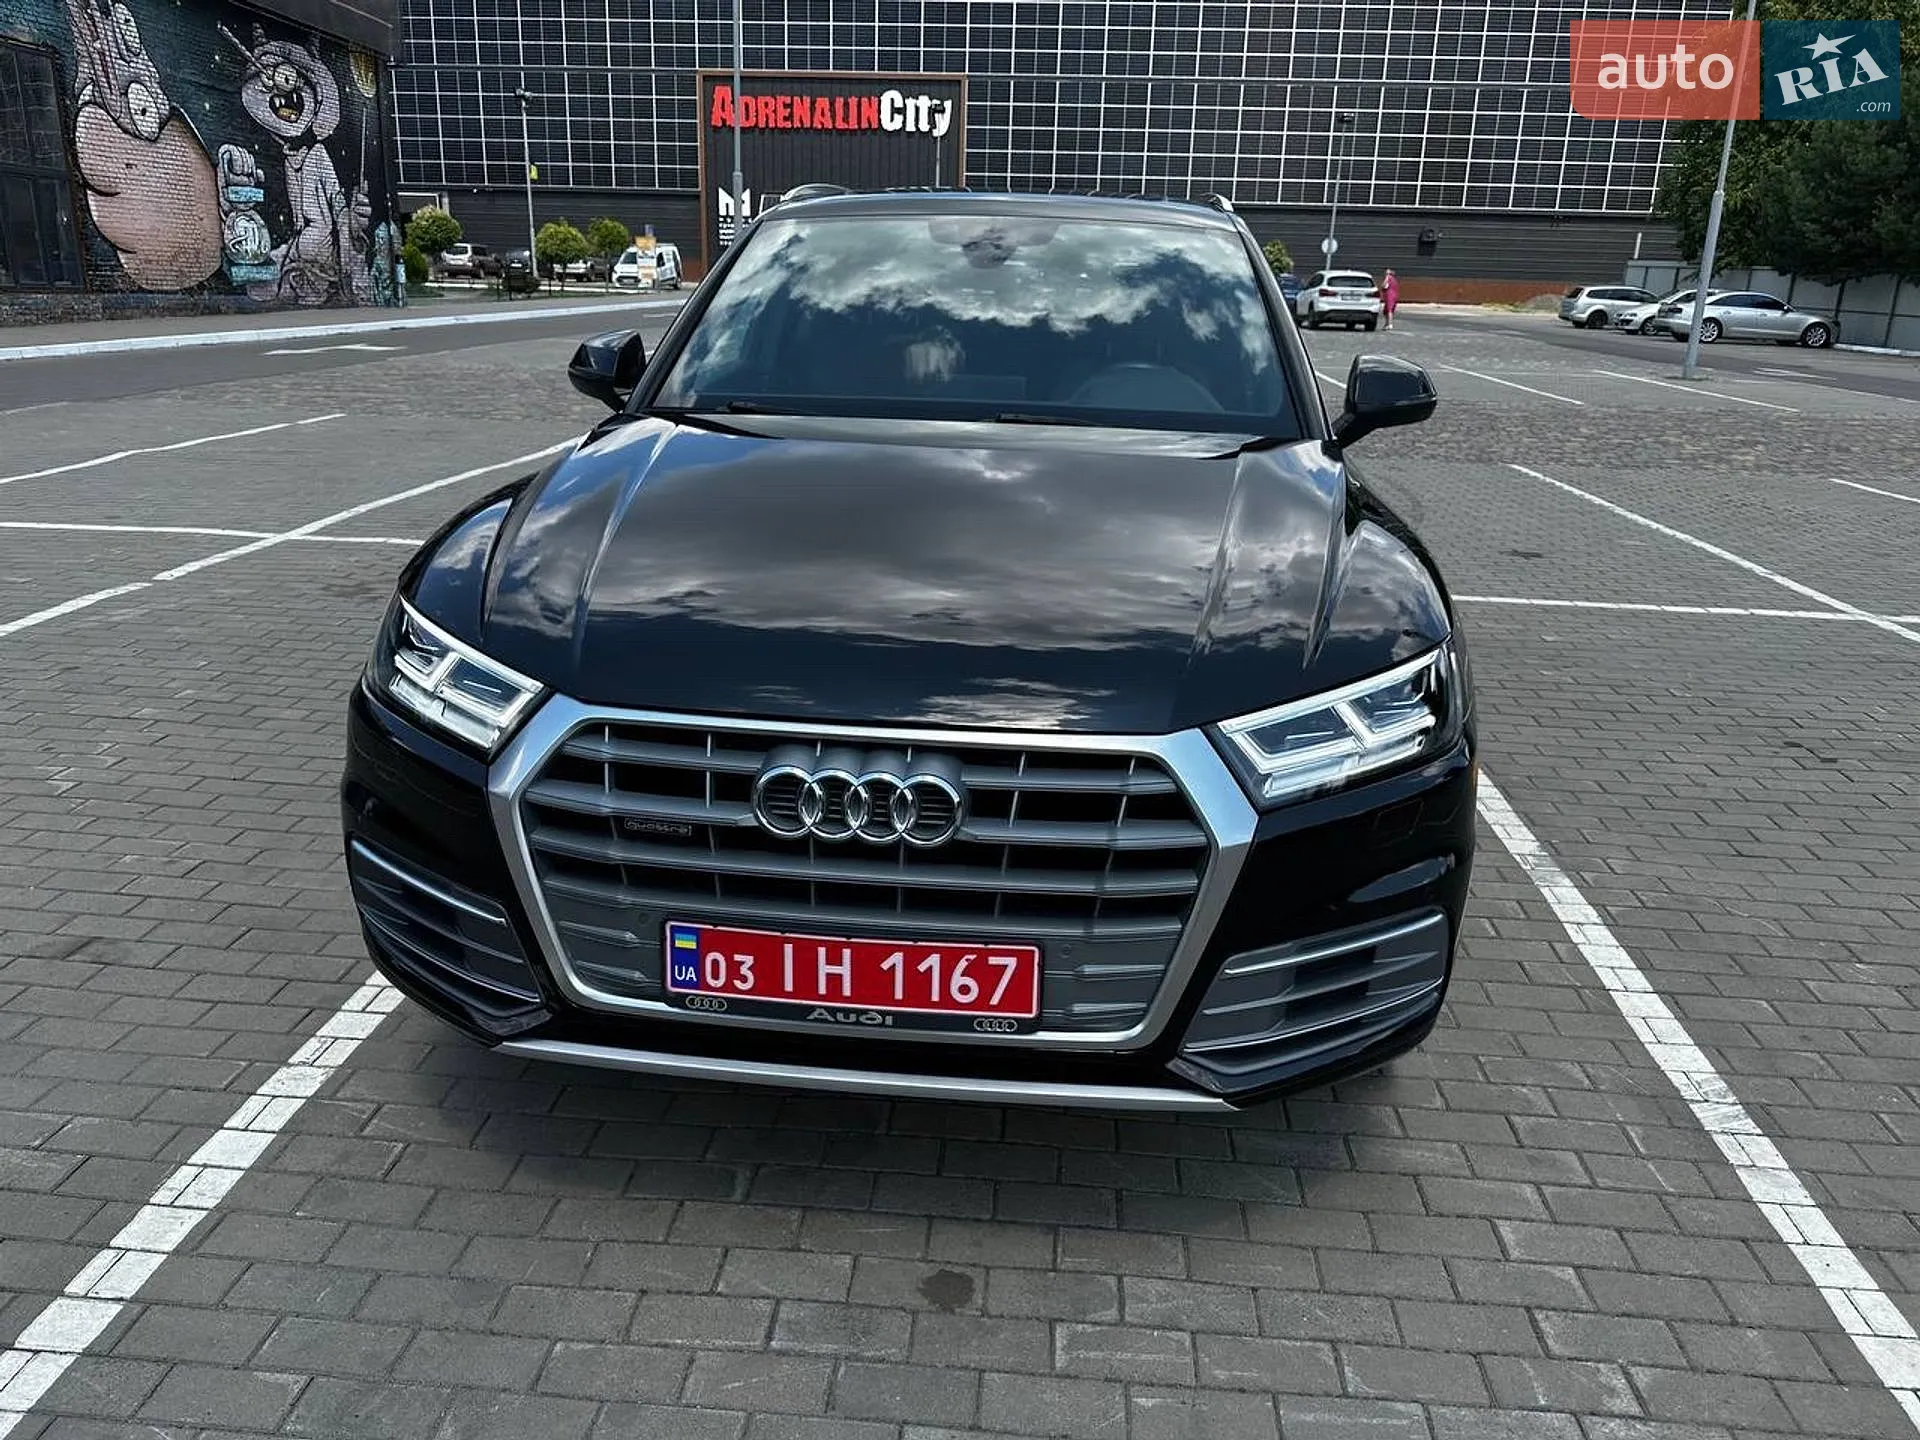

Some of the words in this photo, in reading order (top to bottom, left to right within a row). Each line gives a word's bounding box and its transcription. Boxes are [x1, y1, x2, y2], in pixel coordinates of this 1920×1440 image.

[674, 964, 697, 982] UA
[704, 951, 755, 991] 03
[879, 951, 1018, 1006] 1167
[805, 1007, 894, 1027] Audi
